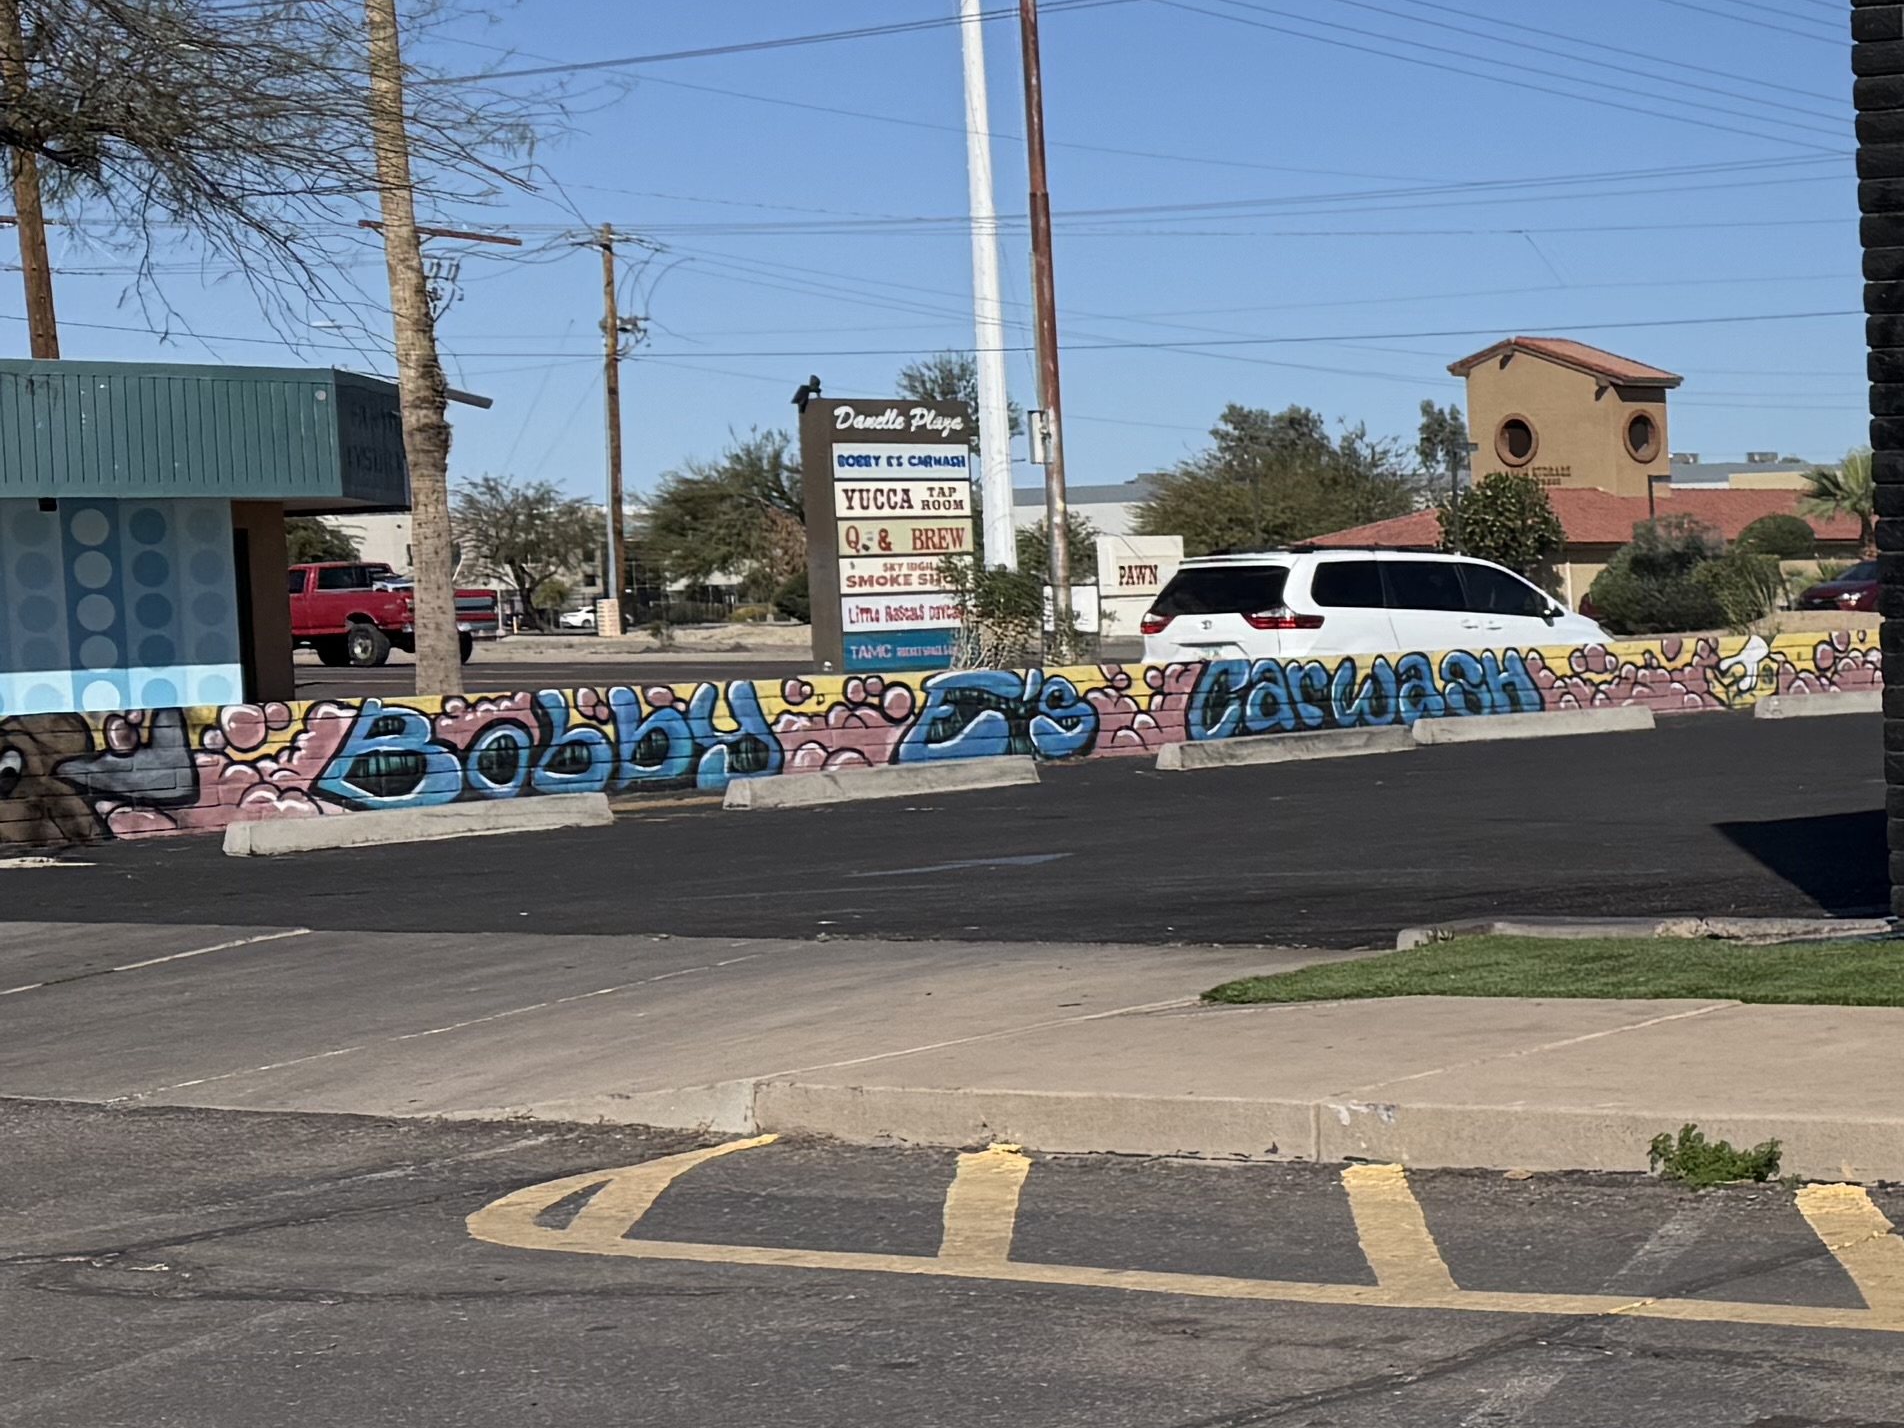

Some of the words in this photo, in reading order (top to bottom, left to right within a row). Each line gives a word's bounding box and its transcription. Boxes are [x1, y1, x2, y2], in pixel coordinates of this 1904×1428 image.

[833, 405, 905, 430] Danelle
[909, 406, 963, 438] Plaza
[837, 454, 882, 468] BOBBY
[907, 455, 966, 469] CARWASH
[842, 488, 914, 511] YUCCA
[926, 486, 957, 498] TAP
[920, 499, 965, 511] ROOM
[878, 528, 893, 552] &
[911, 527, 965, 551] BREW
[882, 562, 904, 573] SKY
[1118, 564, 1159, 586] PAWN
[846, 573, 913, 589] SMOKE
[917, 573, 956, 587] SHO
[850, 644, 893, 660] TAMC
